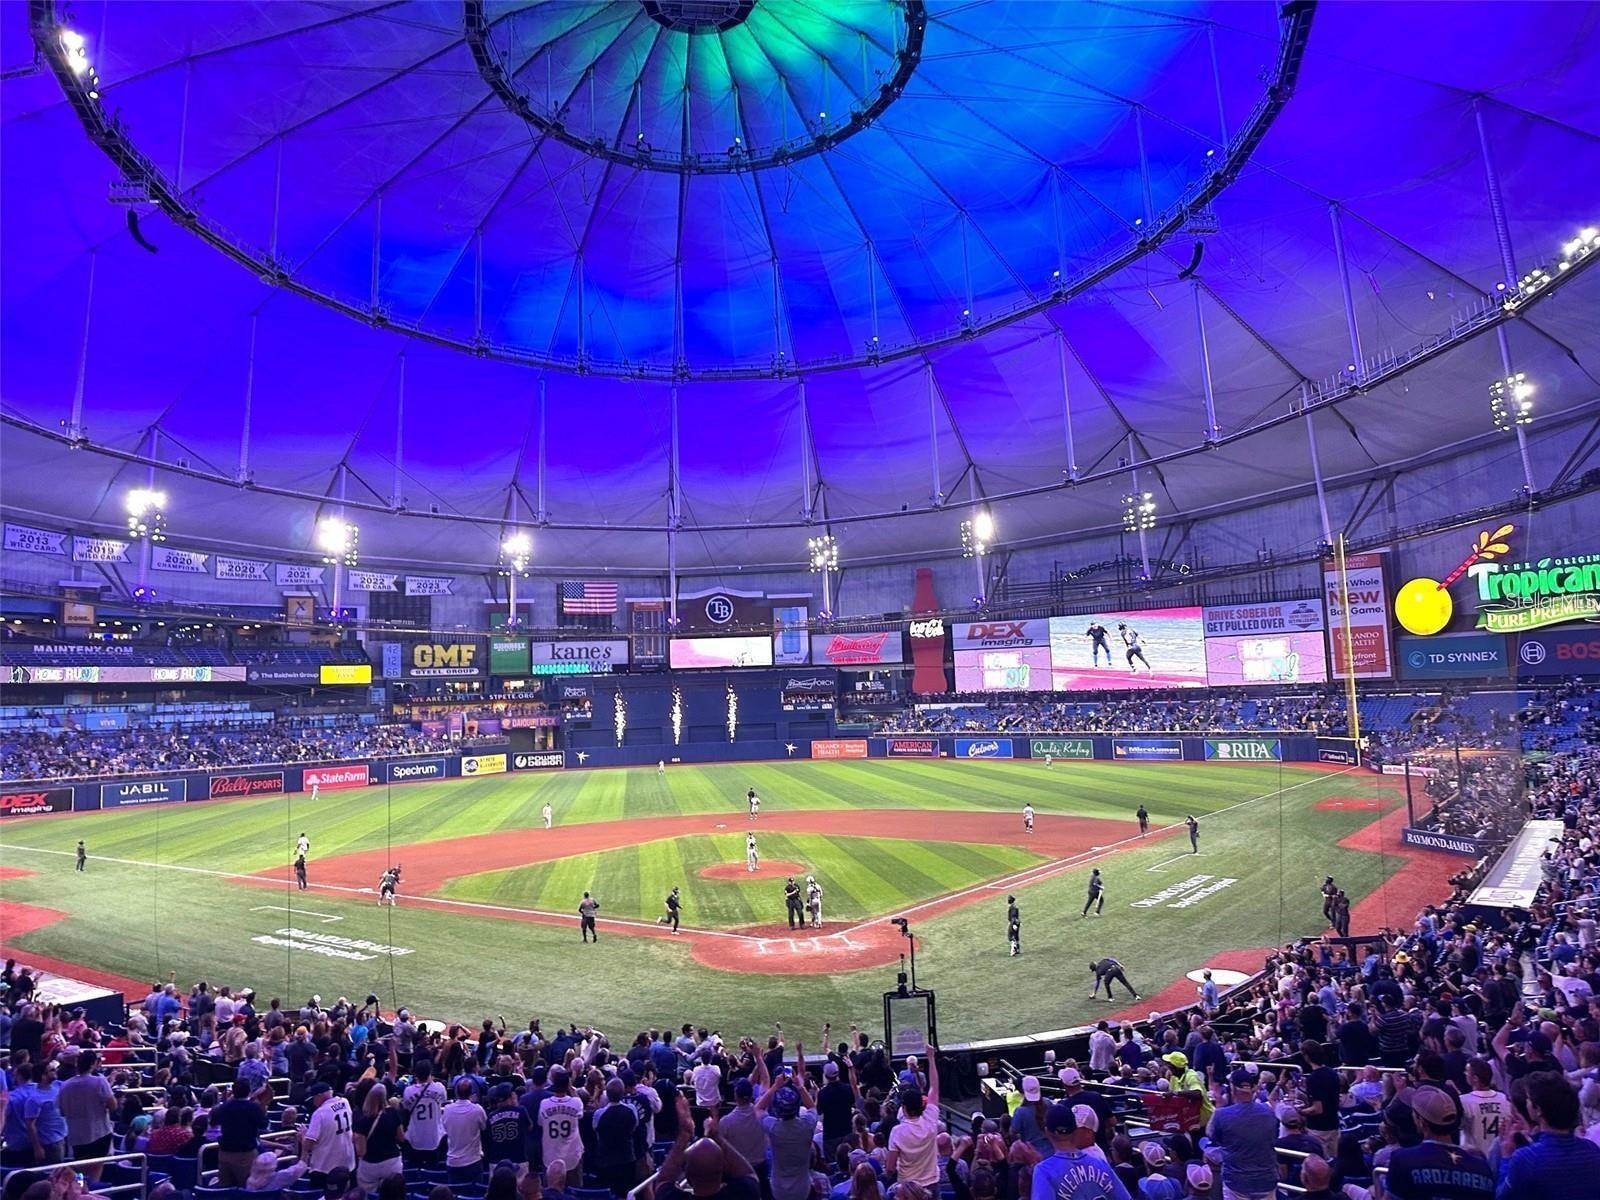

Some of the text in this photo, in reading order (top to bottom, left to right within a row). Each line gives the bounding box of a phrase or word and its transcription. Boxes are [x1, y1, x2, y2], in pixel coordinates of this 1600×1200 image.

[20, 534, 48, 545] 2013
[10, 541, 57, 552] WILD CARD
[87, 545, 114, 554] 2019
[78, 552, 122, 561] WILD CARD
[166, 555, 192, 565] 2020
[157, 562, 199, 571] CHAMPIONS
[227, 565, 255, 573] 2020
[1503, 562, 1531, 571] THE
[220, 571, 262, 579] CHAMPIONS
[360, 577, 385, 585] 2022
[1350, 578, 1379, 587] Whole
[1329, 590, 1380, 606] New
[711, 600, 729, 619] TB
[1208, 606, 1281, 620] DRIVE SOBER OR
[1351, 606, 1384, 615] Game.
[1207, 622, 1228, 632] GET
[1228, 620, 1259, 631] PULLED
[1260, 618, 1285, 629] OVER
[1487, 612, 1528, 628] PURE
[967, 622, 1027, 640] DEX
[1337, 632, 1379, 640] OLANDO
[981, 638, 1034, 646] imaging
[33, 645, 134, 655] MAINTENX.COM
[387, 645, 399, 654] 42
[387, 656, 398, 666] 12
[414, 645, 476, 667] GMF
[1429, 651, 1498, 663] TD SYNNEX
[34, 668, 64, 681] HOME
[154, 668, 179, 681] HOME
[385, 668, 399, 676] 66
[539, 717, 557, 726] DECK
[894, 741, 932, 749] AMERICAN
[1033, 741, 1090, 757] Quality Roofing
[1232, 743, 1271, 758] RIPA
[393, 762, 436, 780] Spectrum
[120, 783, 169, 795] JABIL
[211, 776, 281, 795] Bally SPORTS
[0, 793, 48, 808] DEX
[11, 804, 53, 814] imaging
[1407, 833, 1475, 853] RAYMOND JAMES
[416, 1103, 433, 1120] 21
[1479, 1102, 1501, 1114] PRICE
[334, 1111, 351, 1136] 11
[549, 1120, 571, 1139] 69
[1482, 1115, 1499, 1140] 14
[491, 1121, 518, 1142] 56
[1057, 1165, 1113, 1200] KIERMAIER
[1411, 1168, 1494, 1192] AROZARENA
